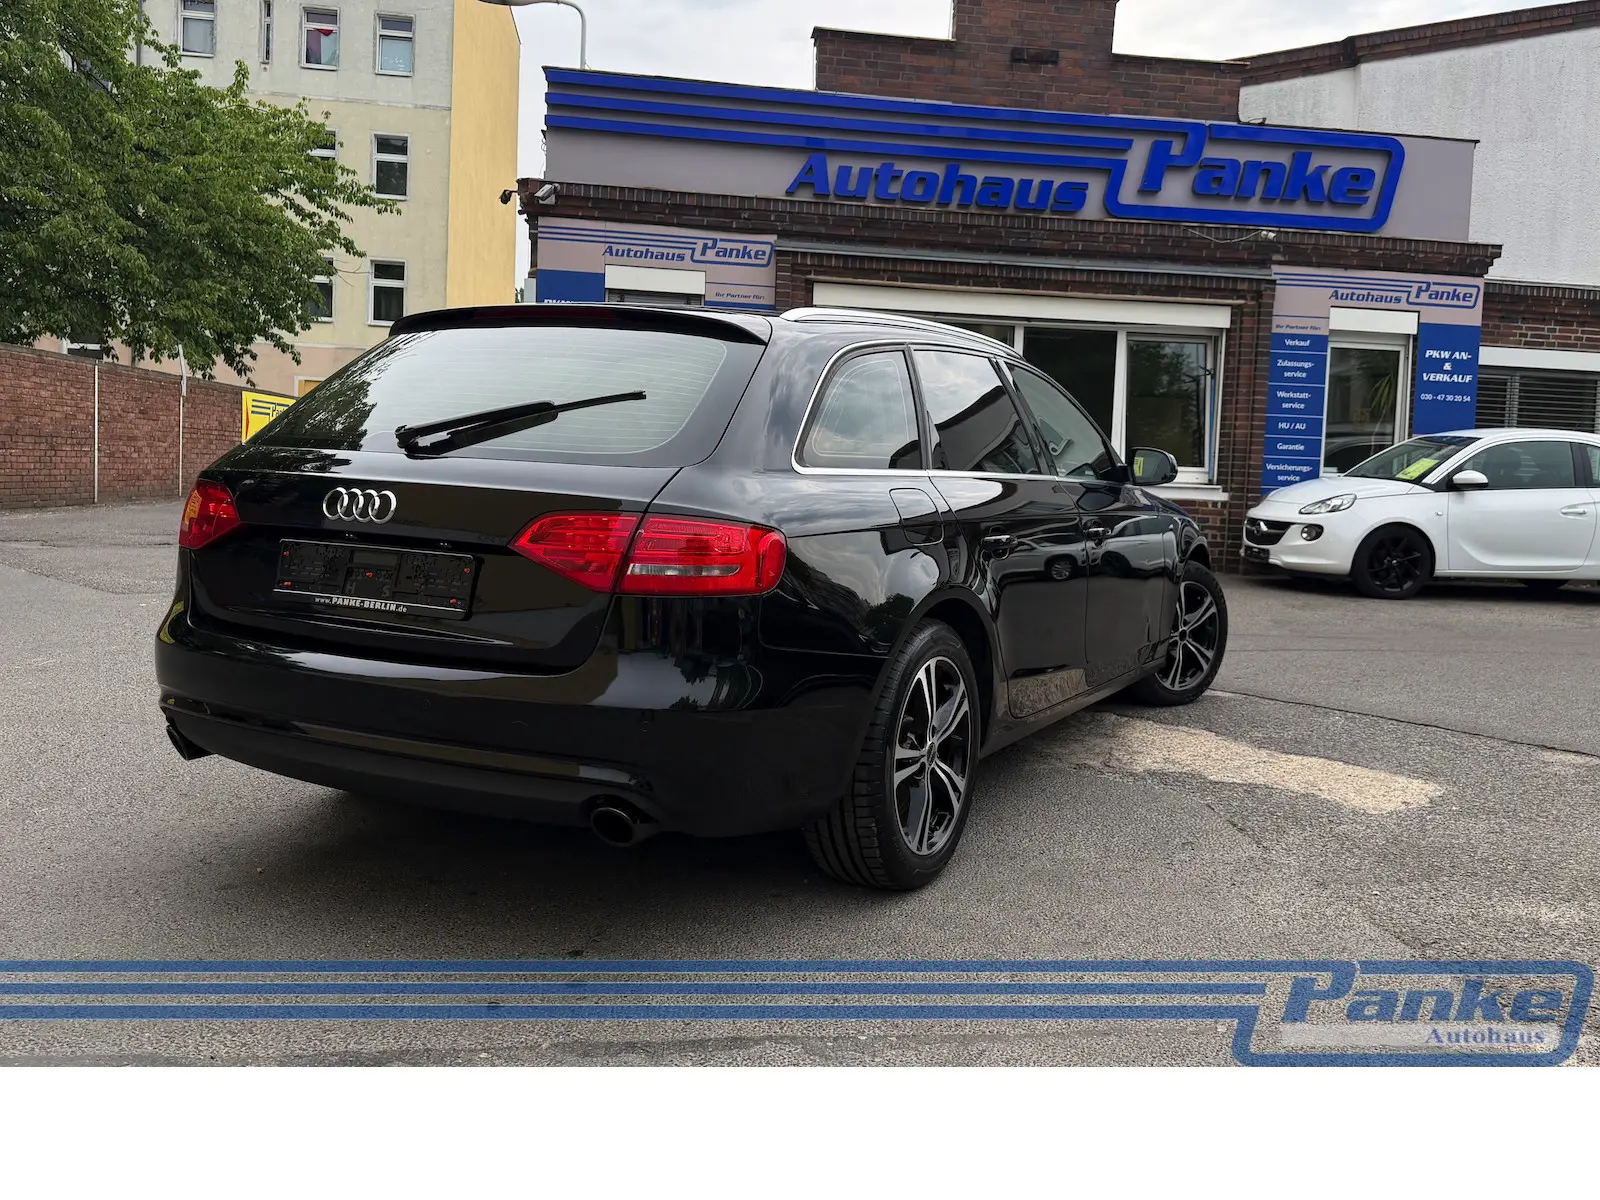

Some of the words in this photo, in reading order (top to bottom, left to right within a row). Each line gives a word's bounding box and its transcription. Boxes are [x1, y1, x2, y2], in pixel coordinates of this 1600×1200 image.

[786, 152, 1089, 212] Autohaus
[1136, 124, 1377, 206] Panke
[602, 245, 685, 262] Autohaus
[700, 238, 767, 261] Panke
[1329, 289, 1402, 304] Autohaus
[1414, 282, 1473, 303] Panke
[1425, 350, 1451, 359] PKW
[1451, 351, 1472, 360] AN-
[1276, 359, 1314, 369] Zulassungs-
[1443, 362, 1452, 371] &
[1422, 372, 1473, 383] VERKAUF
[1276, 391, 1311, 399] Werkstatt-
[1278, 422, 1289, 430] HU
[1276, 443, 1305, 451] Garantie
[1266, 463, 1313, 473] Versicherungs-
[1277, 474, 1300, 482] service
